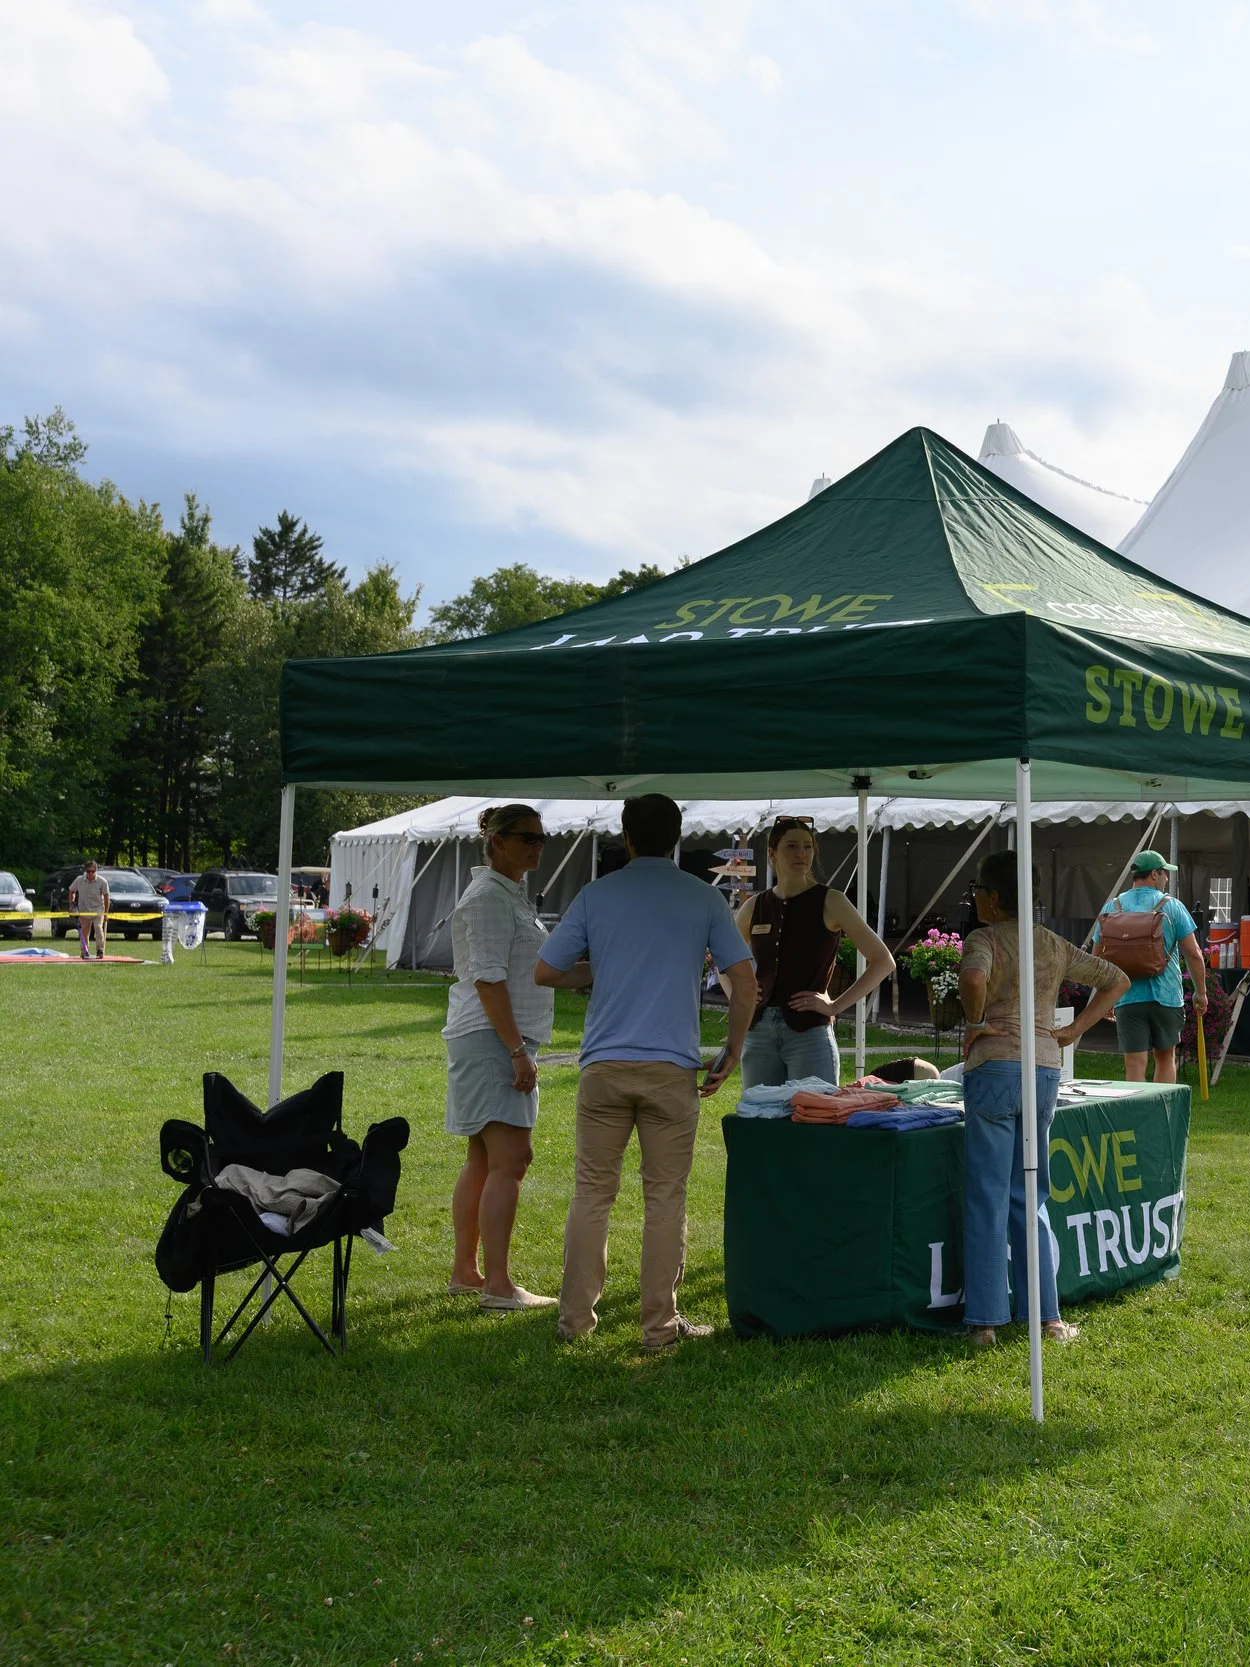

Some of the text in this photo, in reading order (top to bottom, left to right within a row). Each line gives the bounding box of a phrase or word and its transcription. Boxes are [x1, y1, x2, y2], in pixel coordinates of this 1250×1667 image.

[655, 594, 894, 629] STOWE
[1085, 665, 1245, 740] STOWE
[1049, 1130, 1142, 1203] OWE
[1067, 1190, 1184, 1277] TRUST
